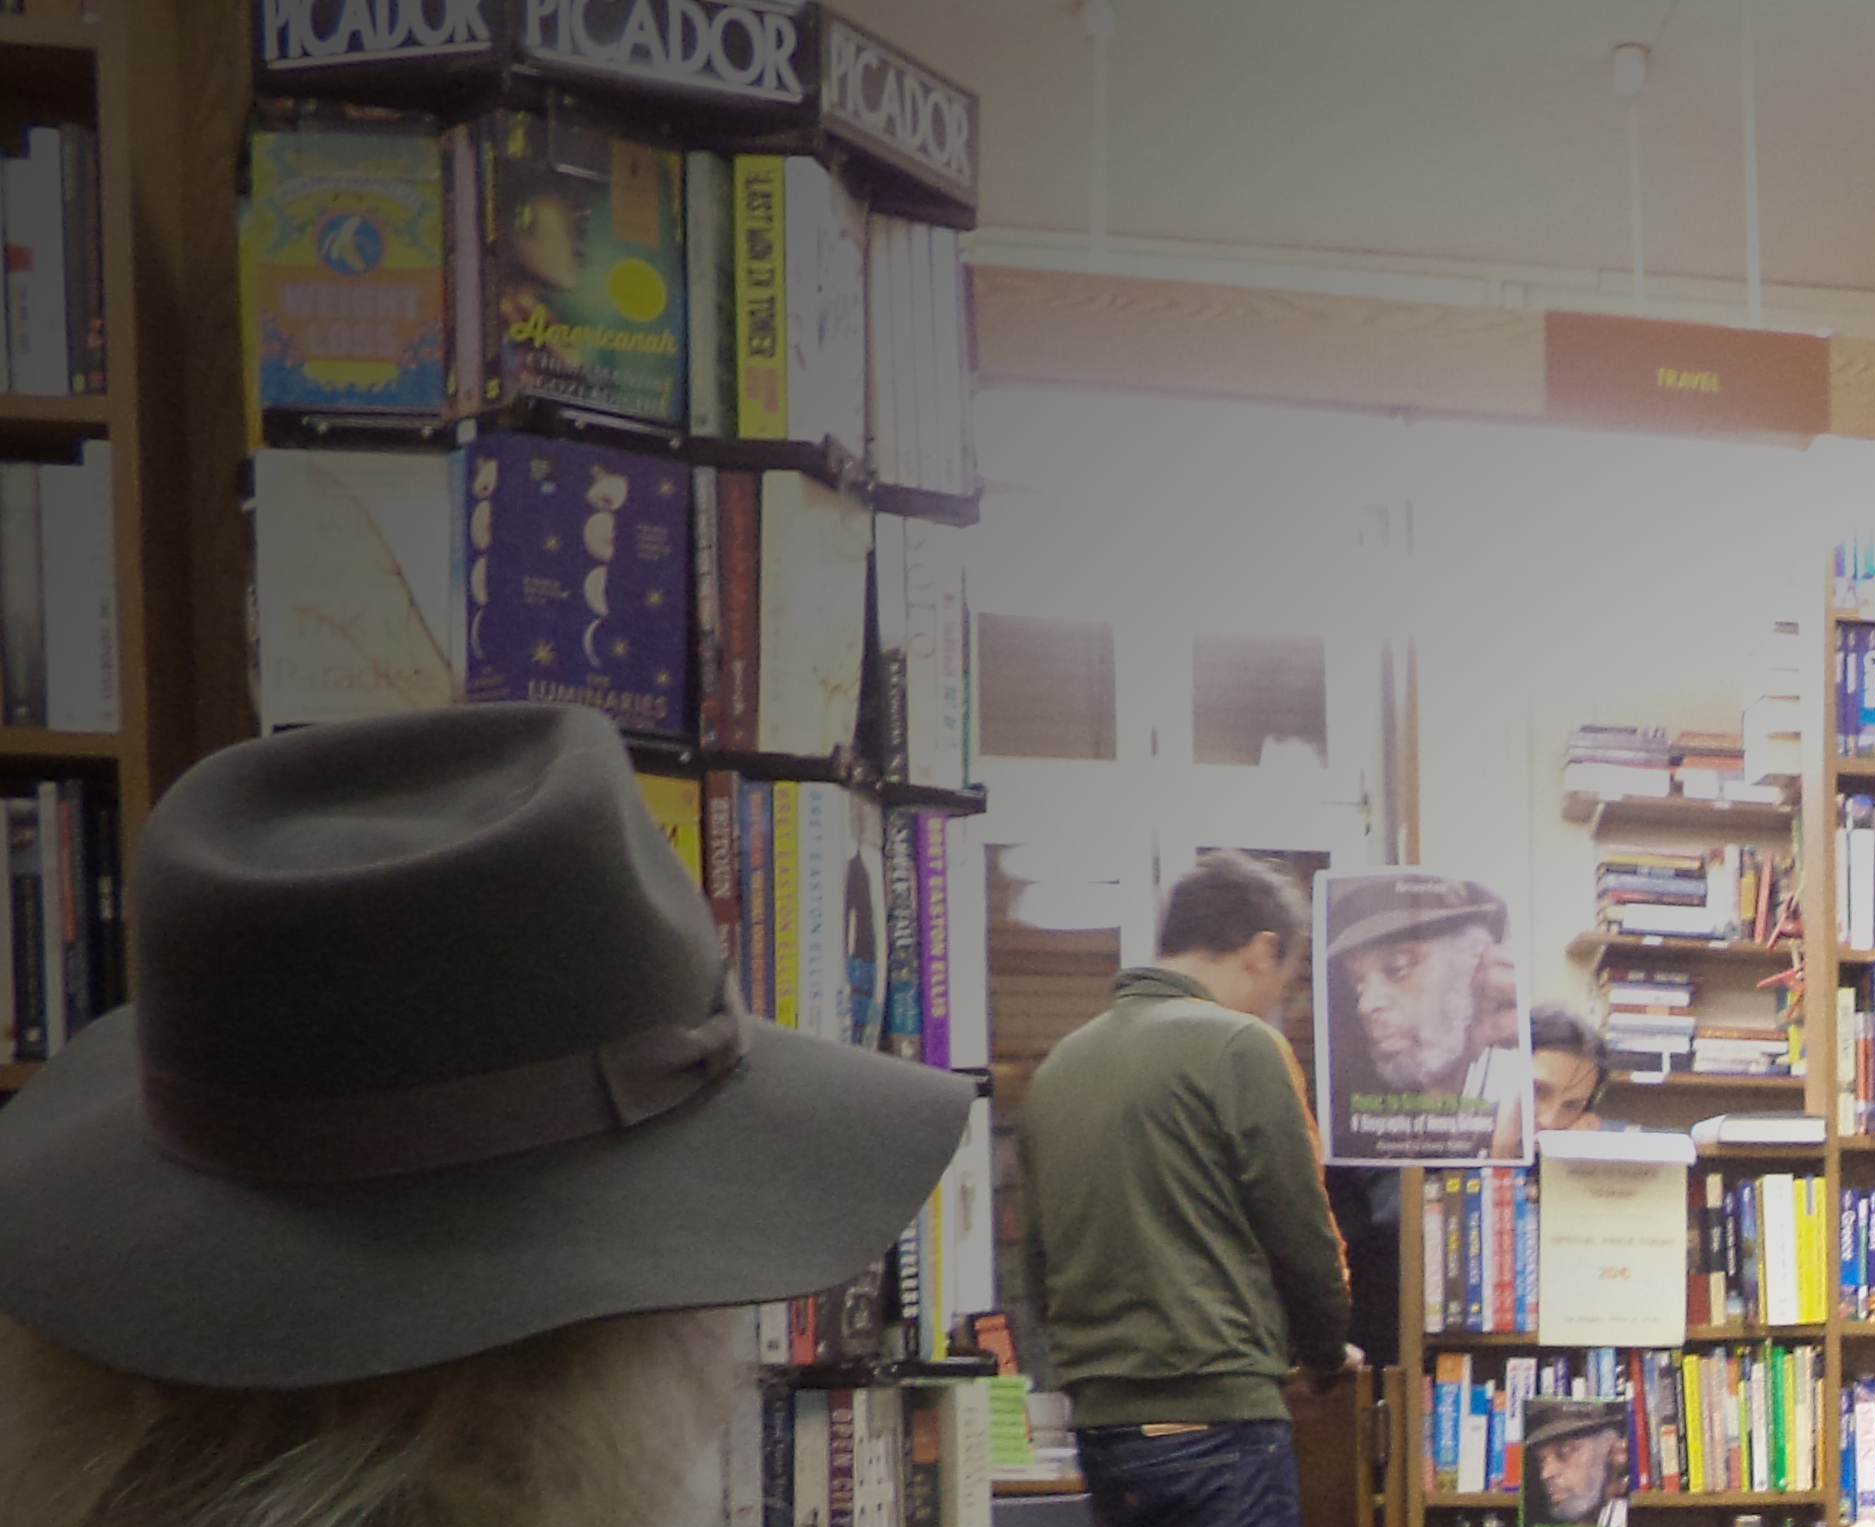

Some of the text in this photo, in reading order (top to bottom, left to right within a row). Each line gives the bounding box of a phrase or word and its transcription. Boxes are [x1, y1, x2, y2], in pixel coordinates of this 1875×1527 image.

[264, 0, 491, 60] PICADOR
[524, 0, 802, 94] PICADOR
[832, 30, 970, 187] PICADOR
[1656, 367, 1721, 393] TRAVEL
[709, 797, 732, 898] ZEITOUN
[808, 791, 822, 999] BRET EASTON ELLIS
[926, 818, 948, 1018] BRET EASTON ELLIS
[831, 1408, 853, 1467] OPEN
[831, 1477, 853, 1527] CITY
